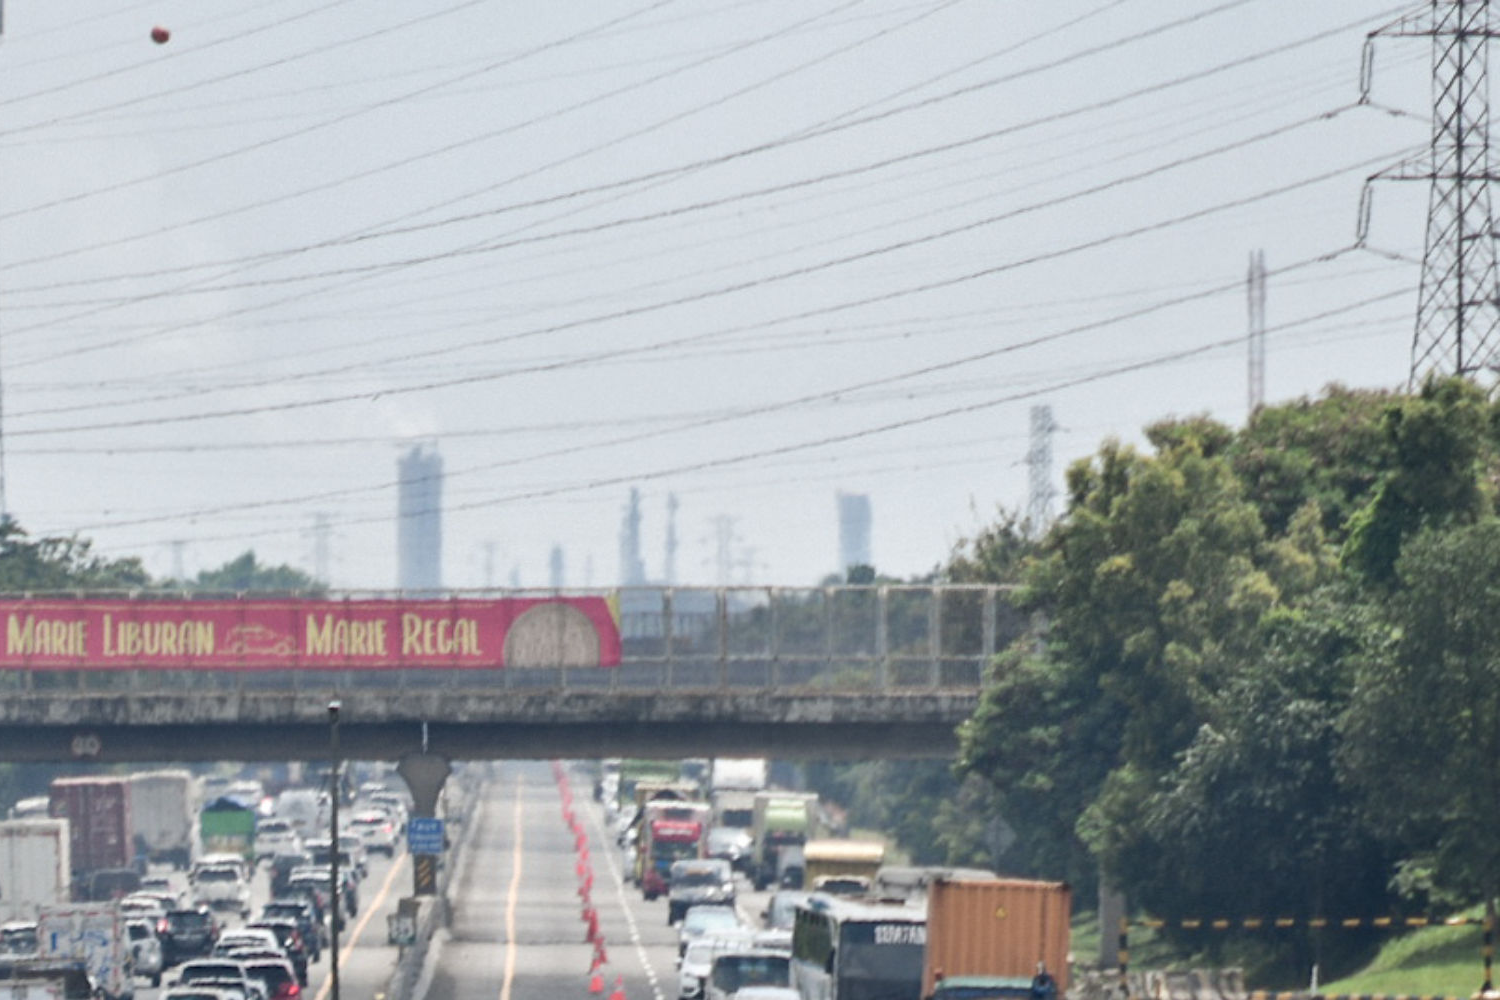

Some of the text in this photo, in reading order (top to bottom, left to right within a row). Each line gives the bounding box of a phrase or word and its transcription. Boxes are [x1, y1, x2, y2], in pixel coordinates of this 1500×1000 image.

[6, 613, 482, 657] MARIE LIBURAN MARIE REGAL
